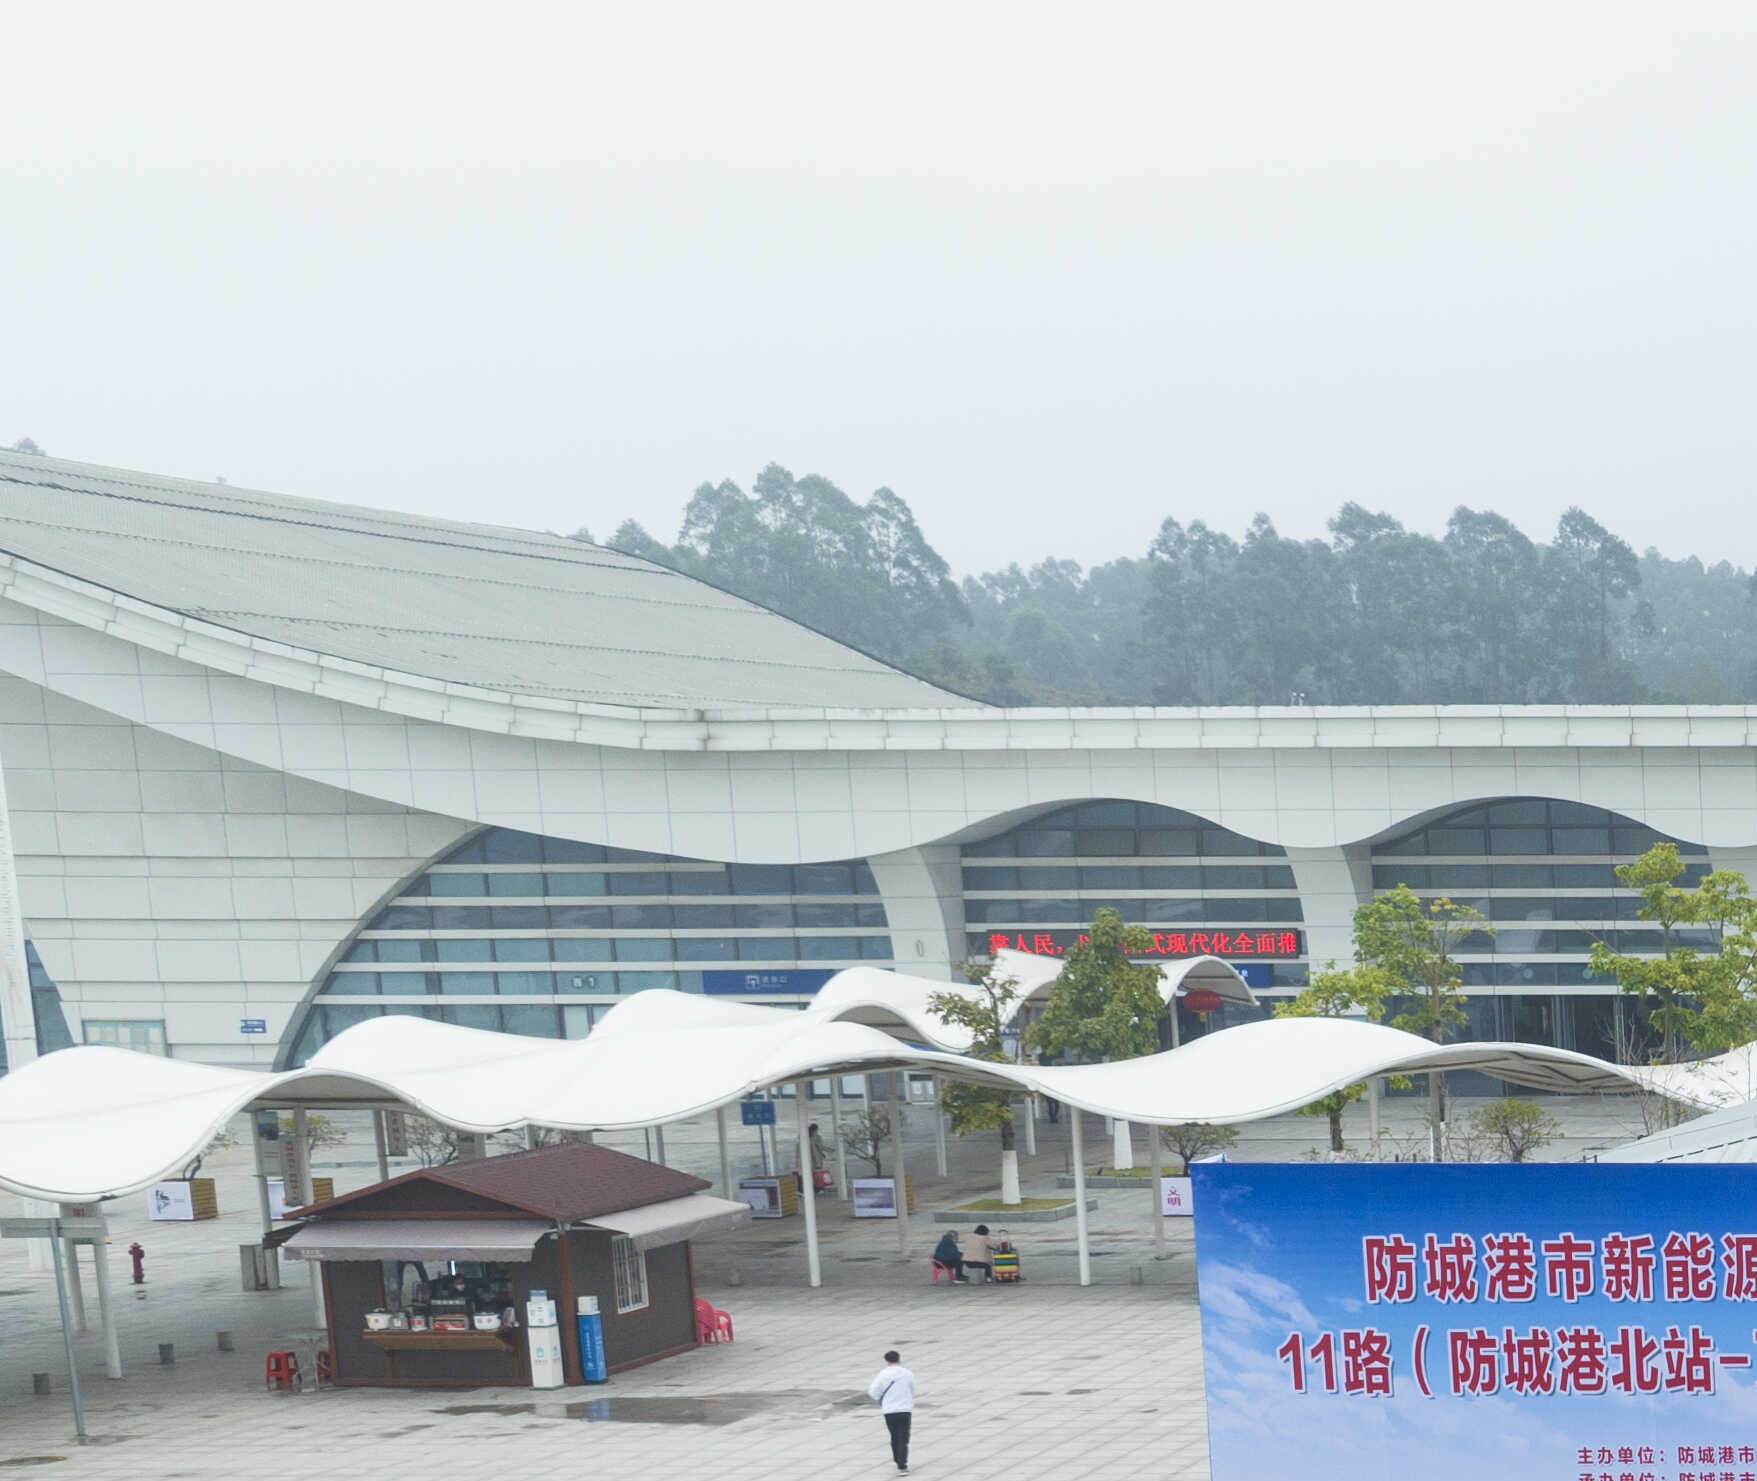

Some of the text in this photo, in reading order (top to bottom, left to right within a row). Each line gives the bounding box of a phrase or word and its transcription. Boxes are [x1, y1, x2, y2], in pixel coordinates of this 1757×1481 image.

[988, 932, 1297, 956] 靠人民，式现代化全面推
